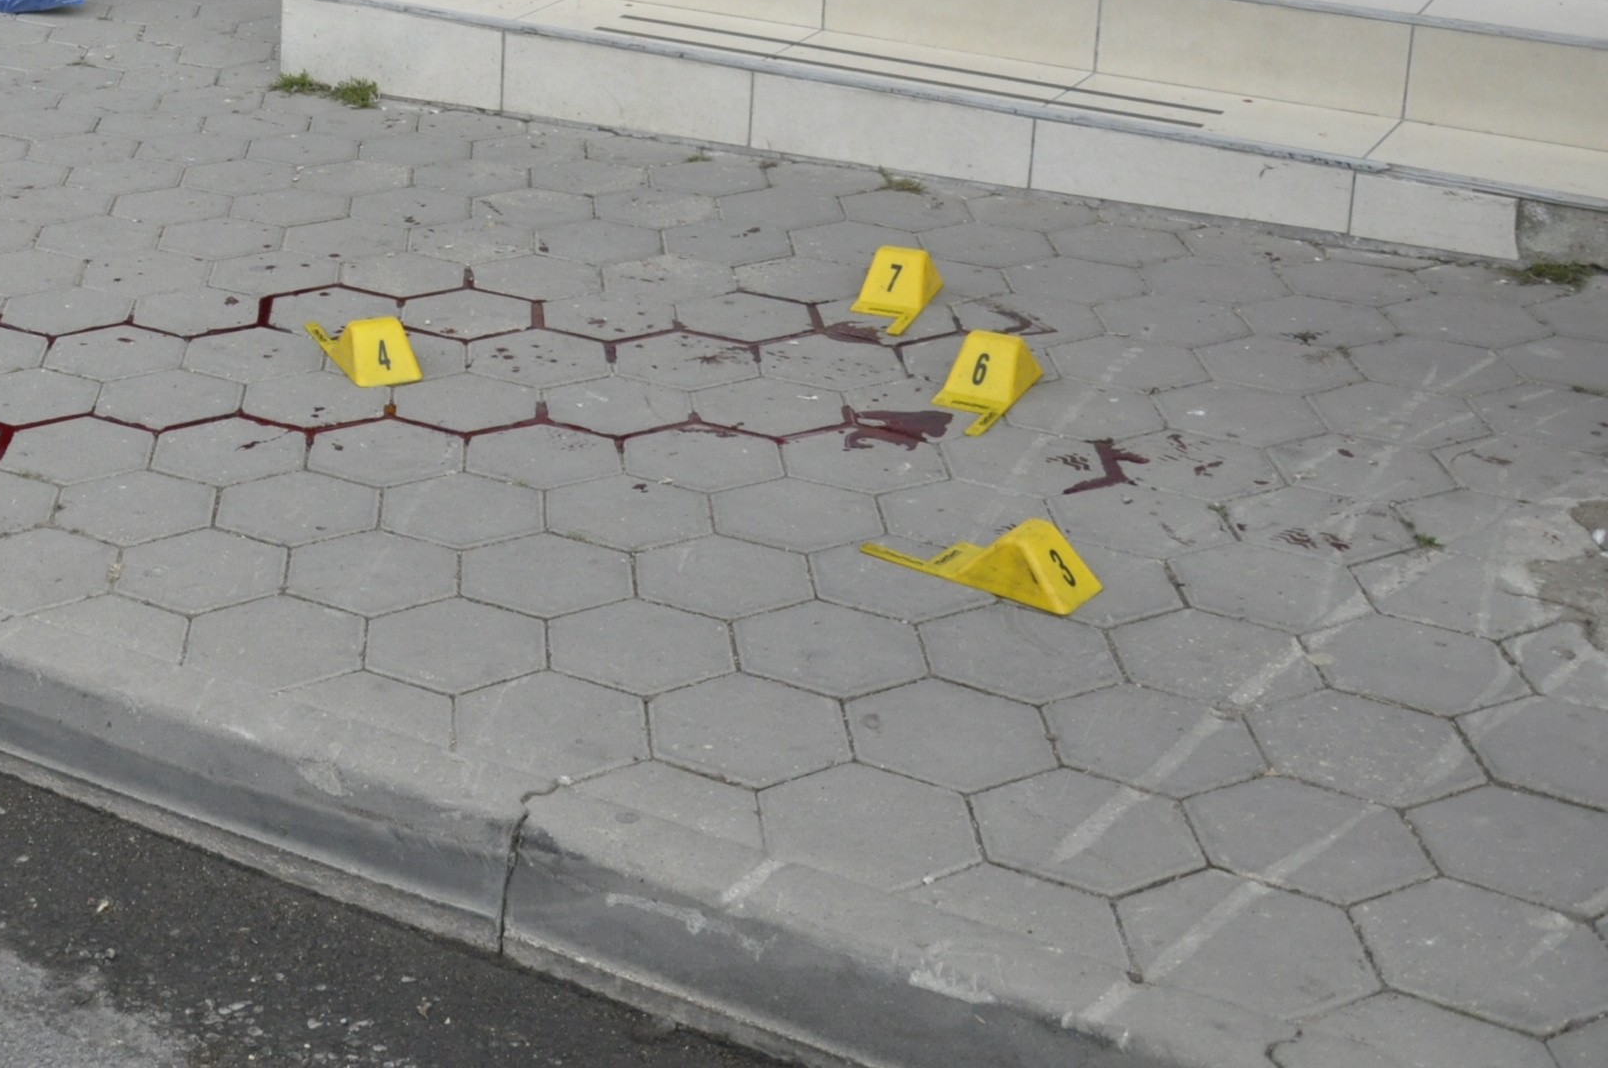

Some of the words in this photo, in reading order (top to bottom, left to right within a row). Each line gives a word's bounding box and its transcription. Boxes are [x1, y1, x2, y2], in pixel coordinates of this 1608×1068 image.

[886, 263, 903, 293] 7
[378, 339, 391, 371] 4
[972, 353, 990, 386] 6
[1049, 548, 1076, 588] 3
